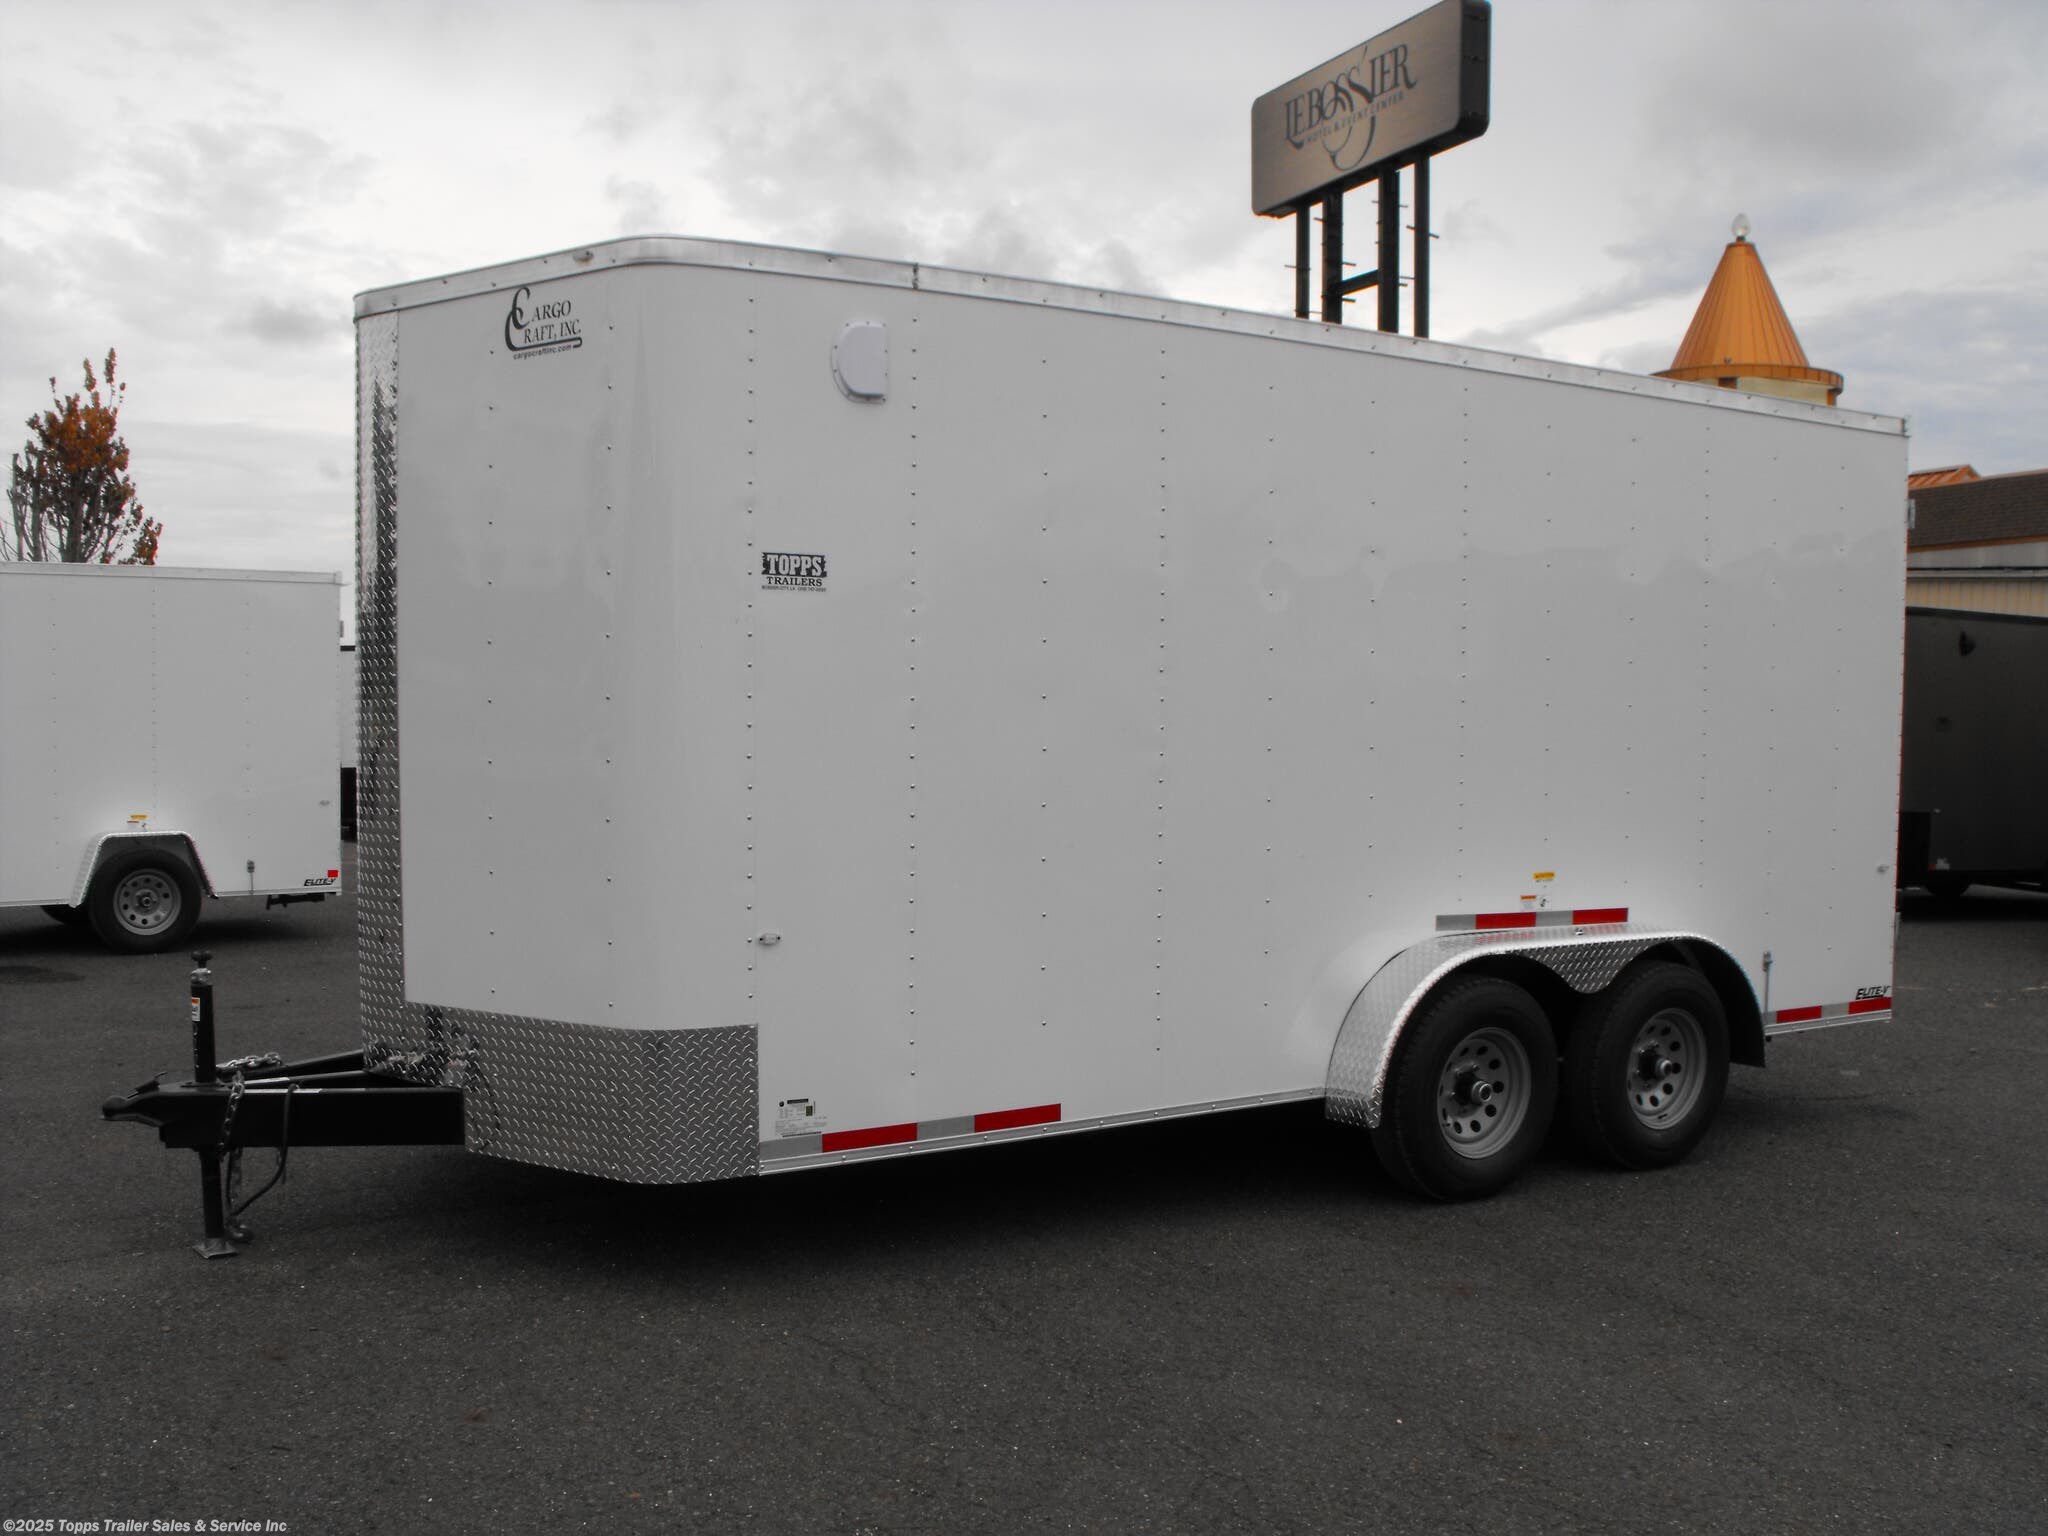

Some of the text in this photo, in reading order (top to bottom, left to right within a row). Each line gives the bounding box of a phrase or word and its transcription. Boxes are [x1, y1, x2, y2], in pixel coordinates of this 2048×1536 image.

[511, 286, 572, 329] CARGO
[766, 554, 823, 576] TOPPS
[766, 576, 823, 587] TRAILERS
